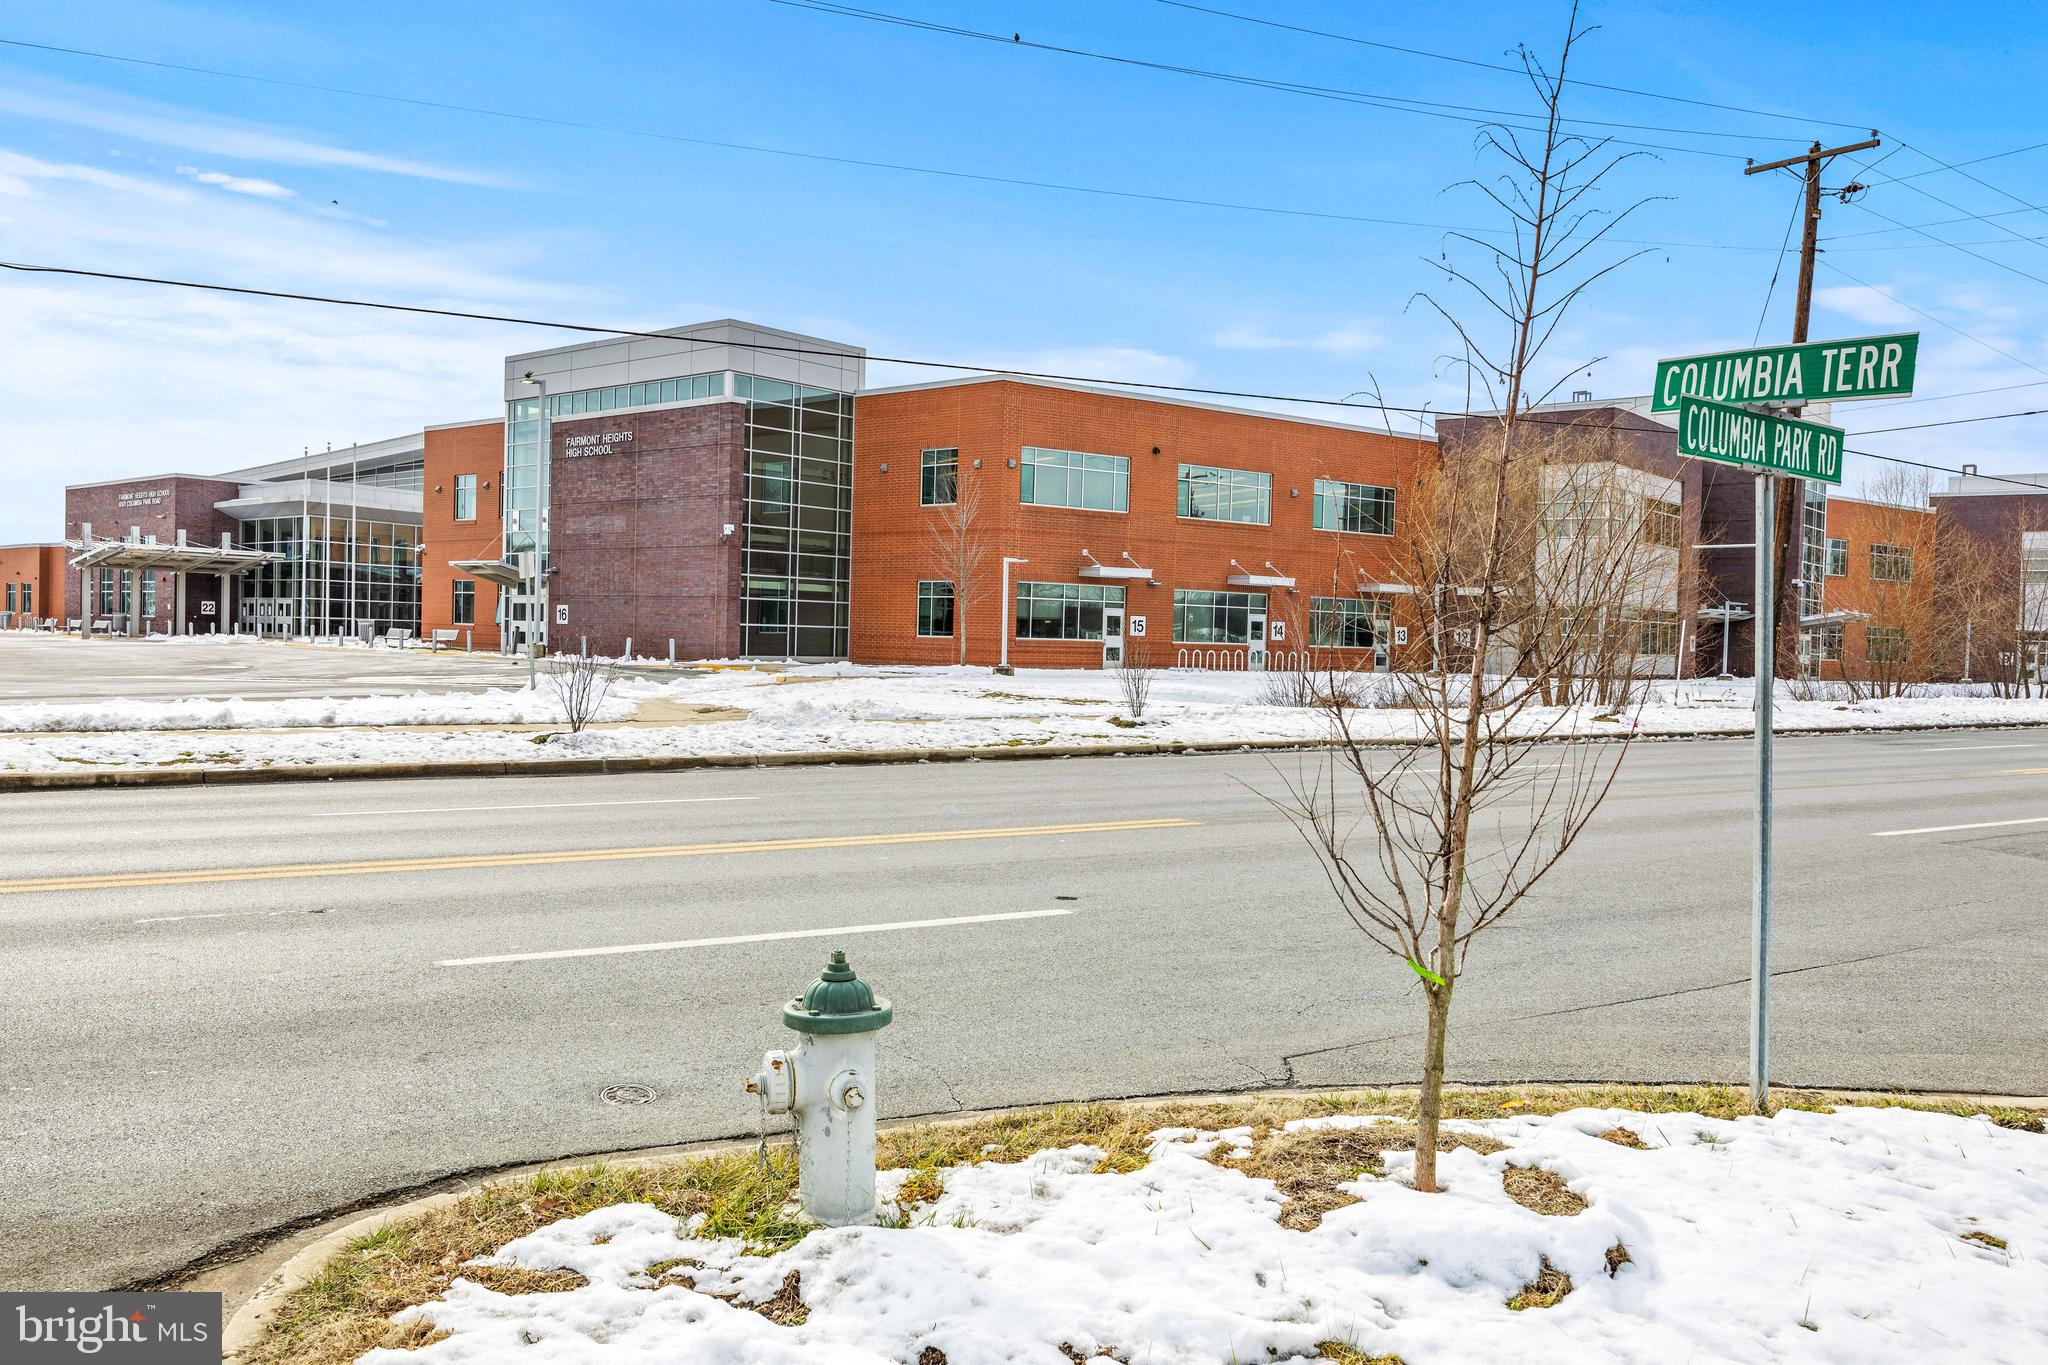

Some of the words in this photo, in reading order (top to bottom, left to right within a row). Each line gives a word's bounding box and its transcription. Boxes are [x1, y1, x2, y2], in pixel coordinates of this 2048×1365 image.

[1663, 352, 1803, 406] COLUMBIA
[1822, 342, 1903, 393] TERR
[566, 435, 600, 447] FAIRMONT
[602, 432, 633, 443] HEIGHTS
[1687, 404, 1766, 463] COLUMBIA
[1773, 423, 1813, 471] PARK
[1817, 433, 1837, 476] RD
[566, 448, 582, 458] HIGH
[584, 445, 613, 456] SCHOOL
[202, 603, 214, 612] 22
[558, 608, 567, 621] 16
[1132, 620, 1144, 633] 15
[1273, 625, 1284, 637] 14
[1397, 630, 1406, 642] 13
